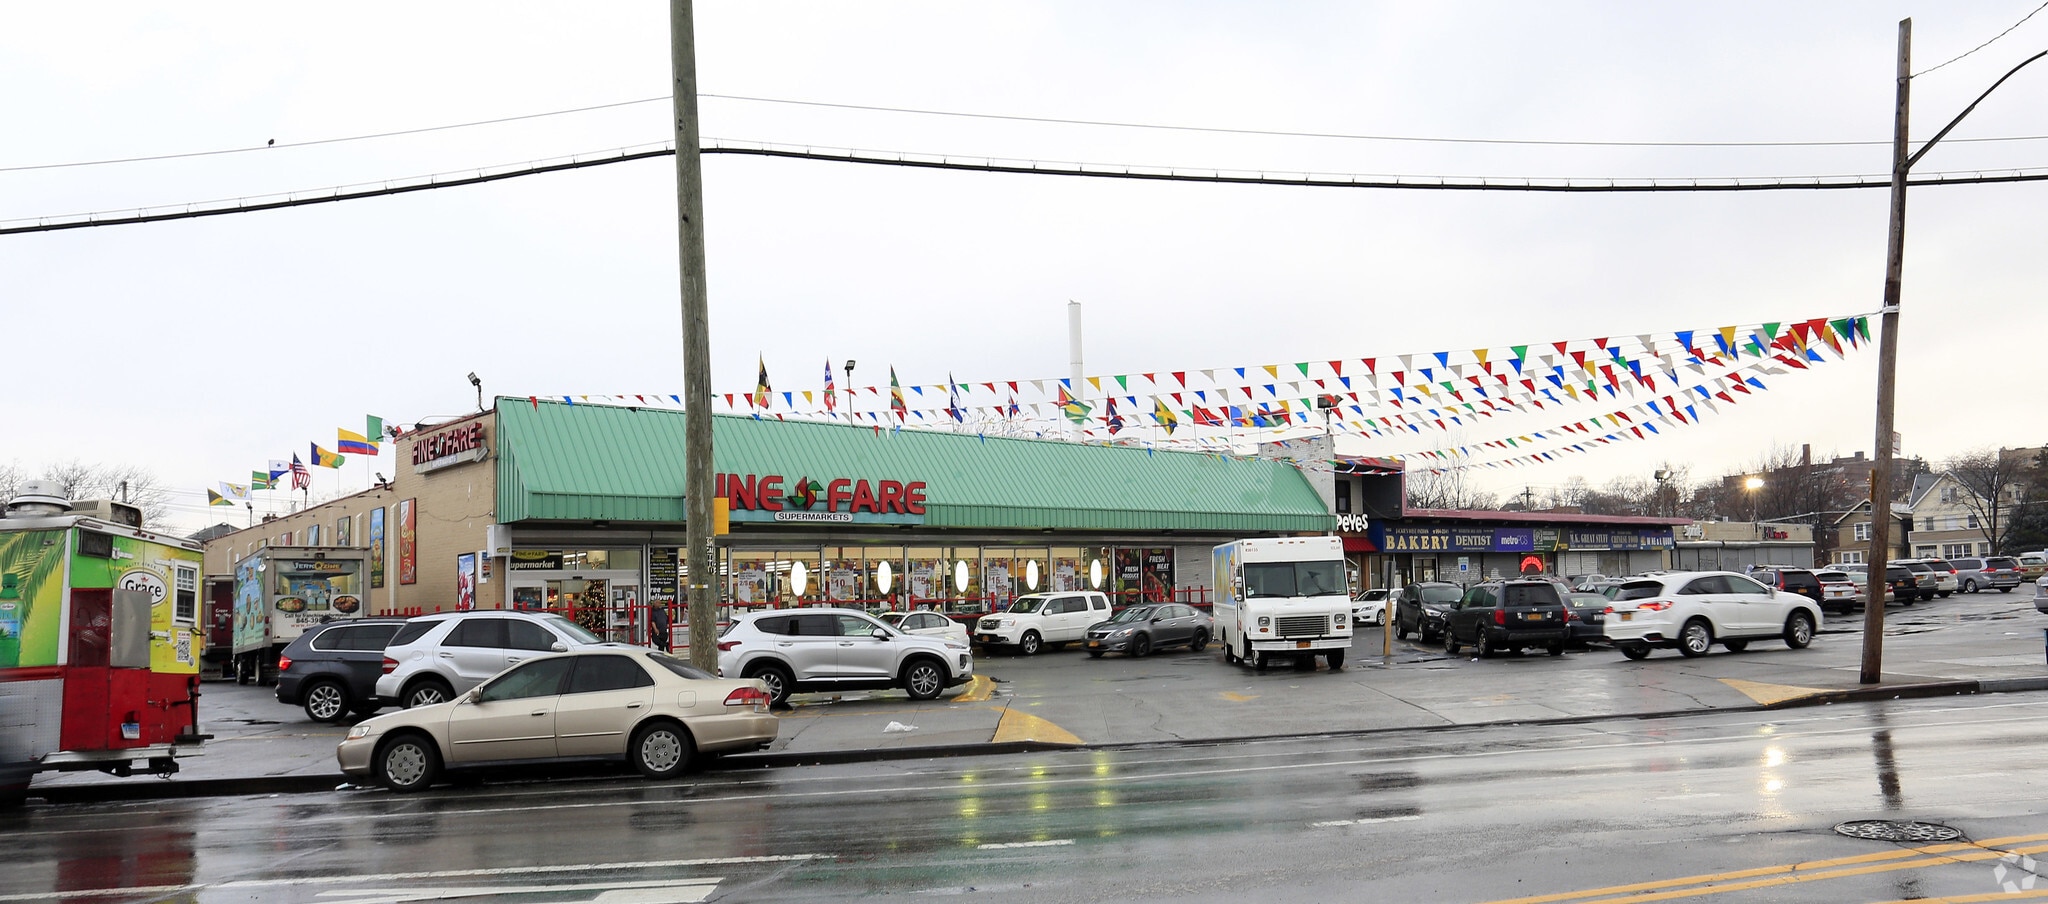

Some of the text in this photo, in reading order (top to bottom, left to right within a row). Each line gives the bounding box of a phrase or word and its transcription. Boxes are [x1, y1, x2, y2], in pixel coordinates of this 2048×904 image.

[412, 422, 483, 465] FINE FARE
[715, 473, 927, 515] INE FARE
[778, 512, 850, 522] SUPERMARKETS
[1385, 535, 1449, 550] BAKERY
[1455, 535, 1492, 546] DENTIST
[1500, 534, 1529, 546] metroPCS
[1580, 533, 1595, 543] GREAT
[1595, 533, 1608, 543] STUFF
[1148, 555, 1166, 563] FRESH
[510, 560, 555, 570] upermarket
[125, 579, 162, 598] Grace
[650, 593, 675, 602] elivery
